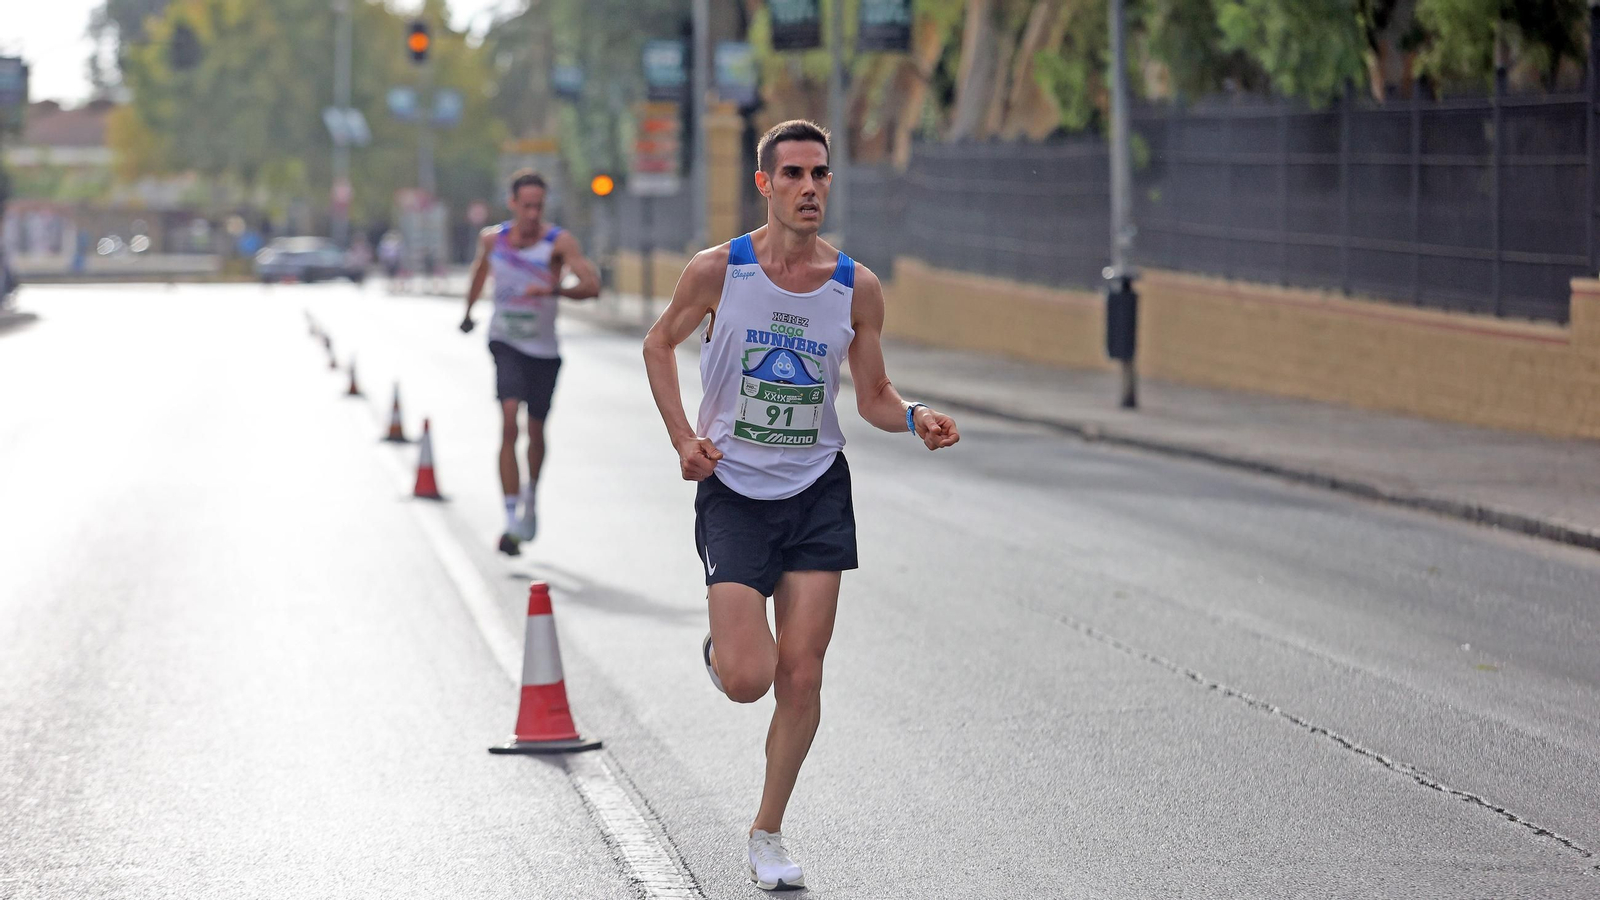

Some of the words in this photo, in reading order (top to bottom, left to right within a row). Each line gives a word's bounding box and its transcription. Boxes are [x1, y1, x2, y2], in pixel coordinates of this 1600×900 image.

[771, 312, 810, 327] XEREZ
[770, 323, 804, 338] caga
[746, 329, 828, 357] RUNNERS
[764, 391, 786, 402] XXIX
[766, 405, 794, 427] 91
